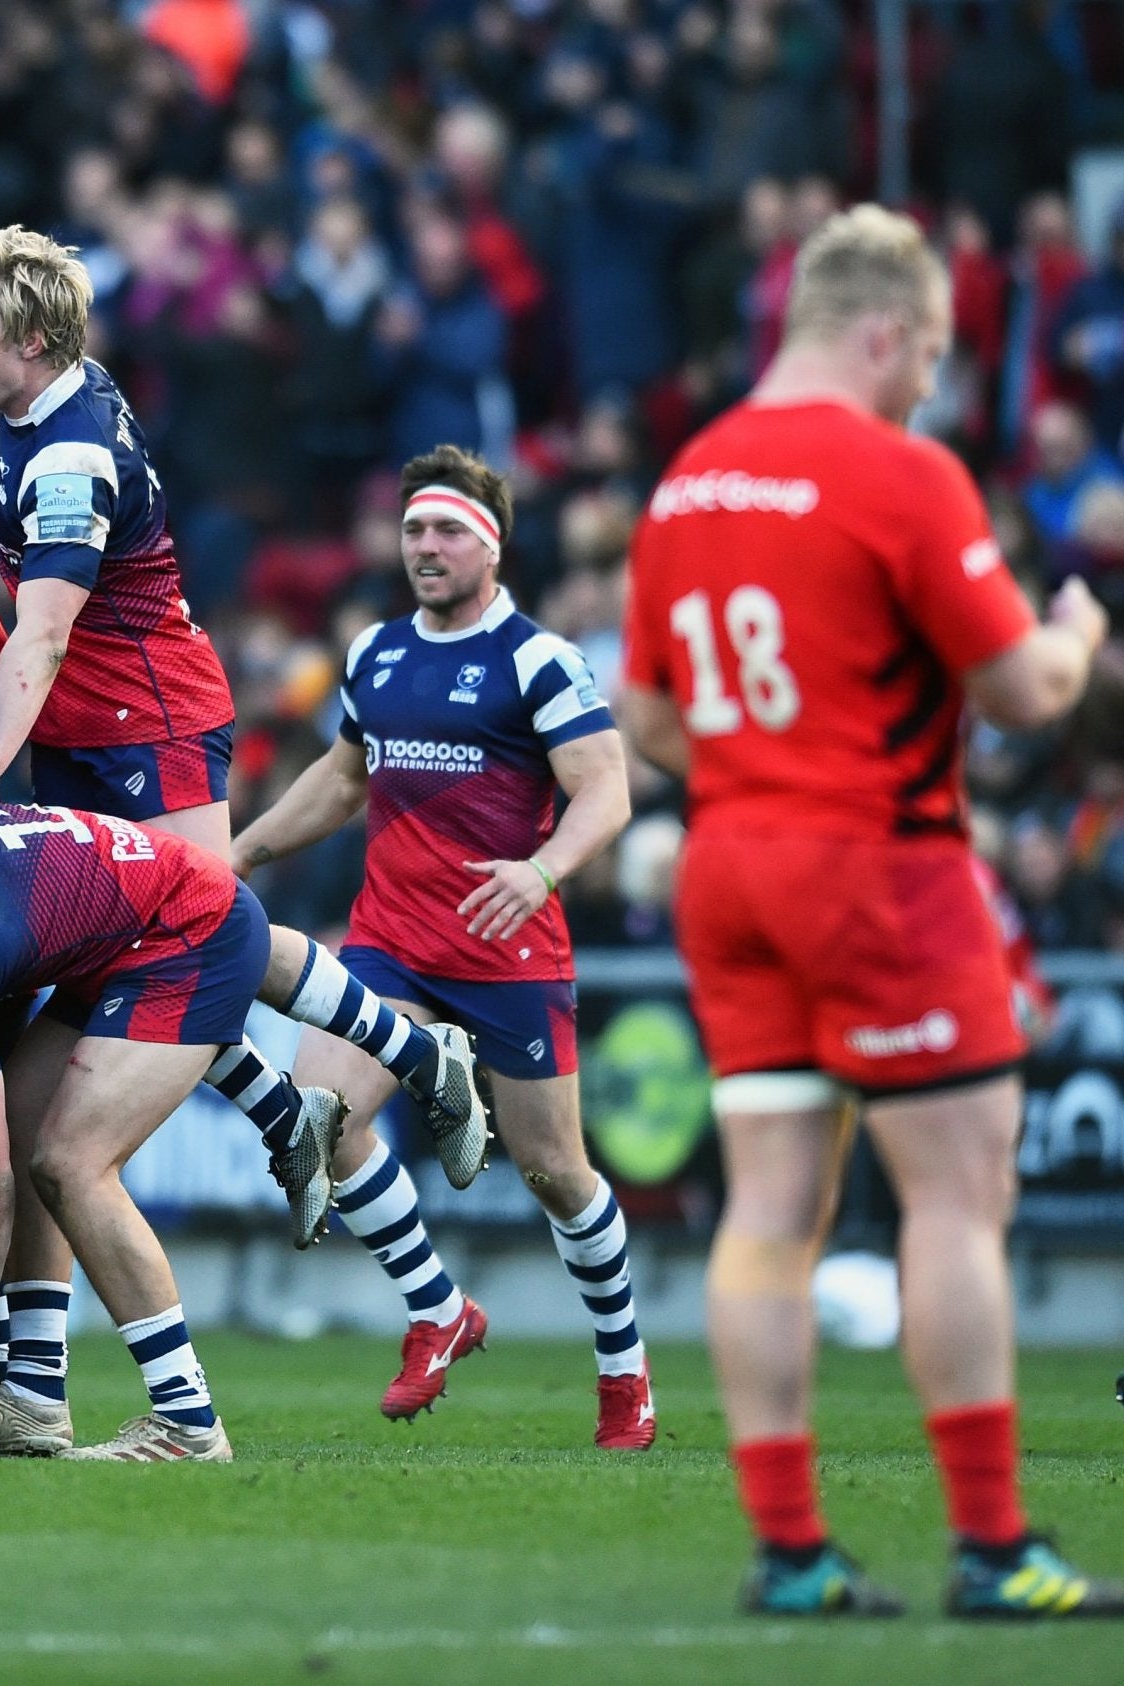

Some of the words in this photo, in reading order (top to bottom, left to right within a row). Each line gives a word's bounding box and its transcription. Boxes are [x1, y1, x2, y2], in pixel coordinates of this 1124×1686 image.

[669, 582, 802, 736] 18
[384, 740, 483, 762] TOOGOOD
[384, 758, 484, 773] INTERNATIONAL
